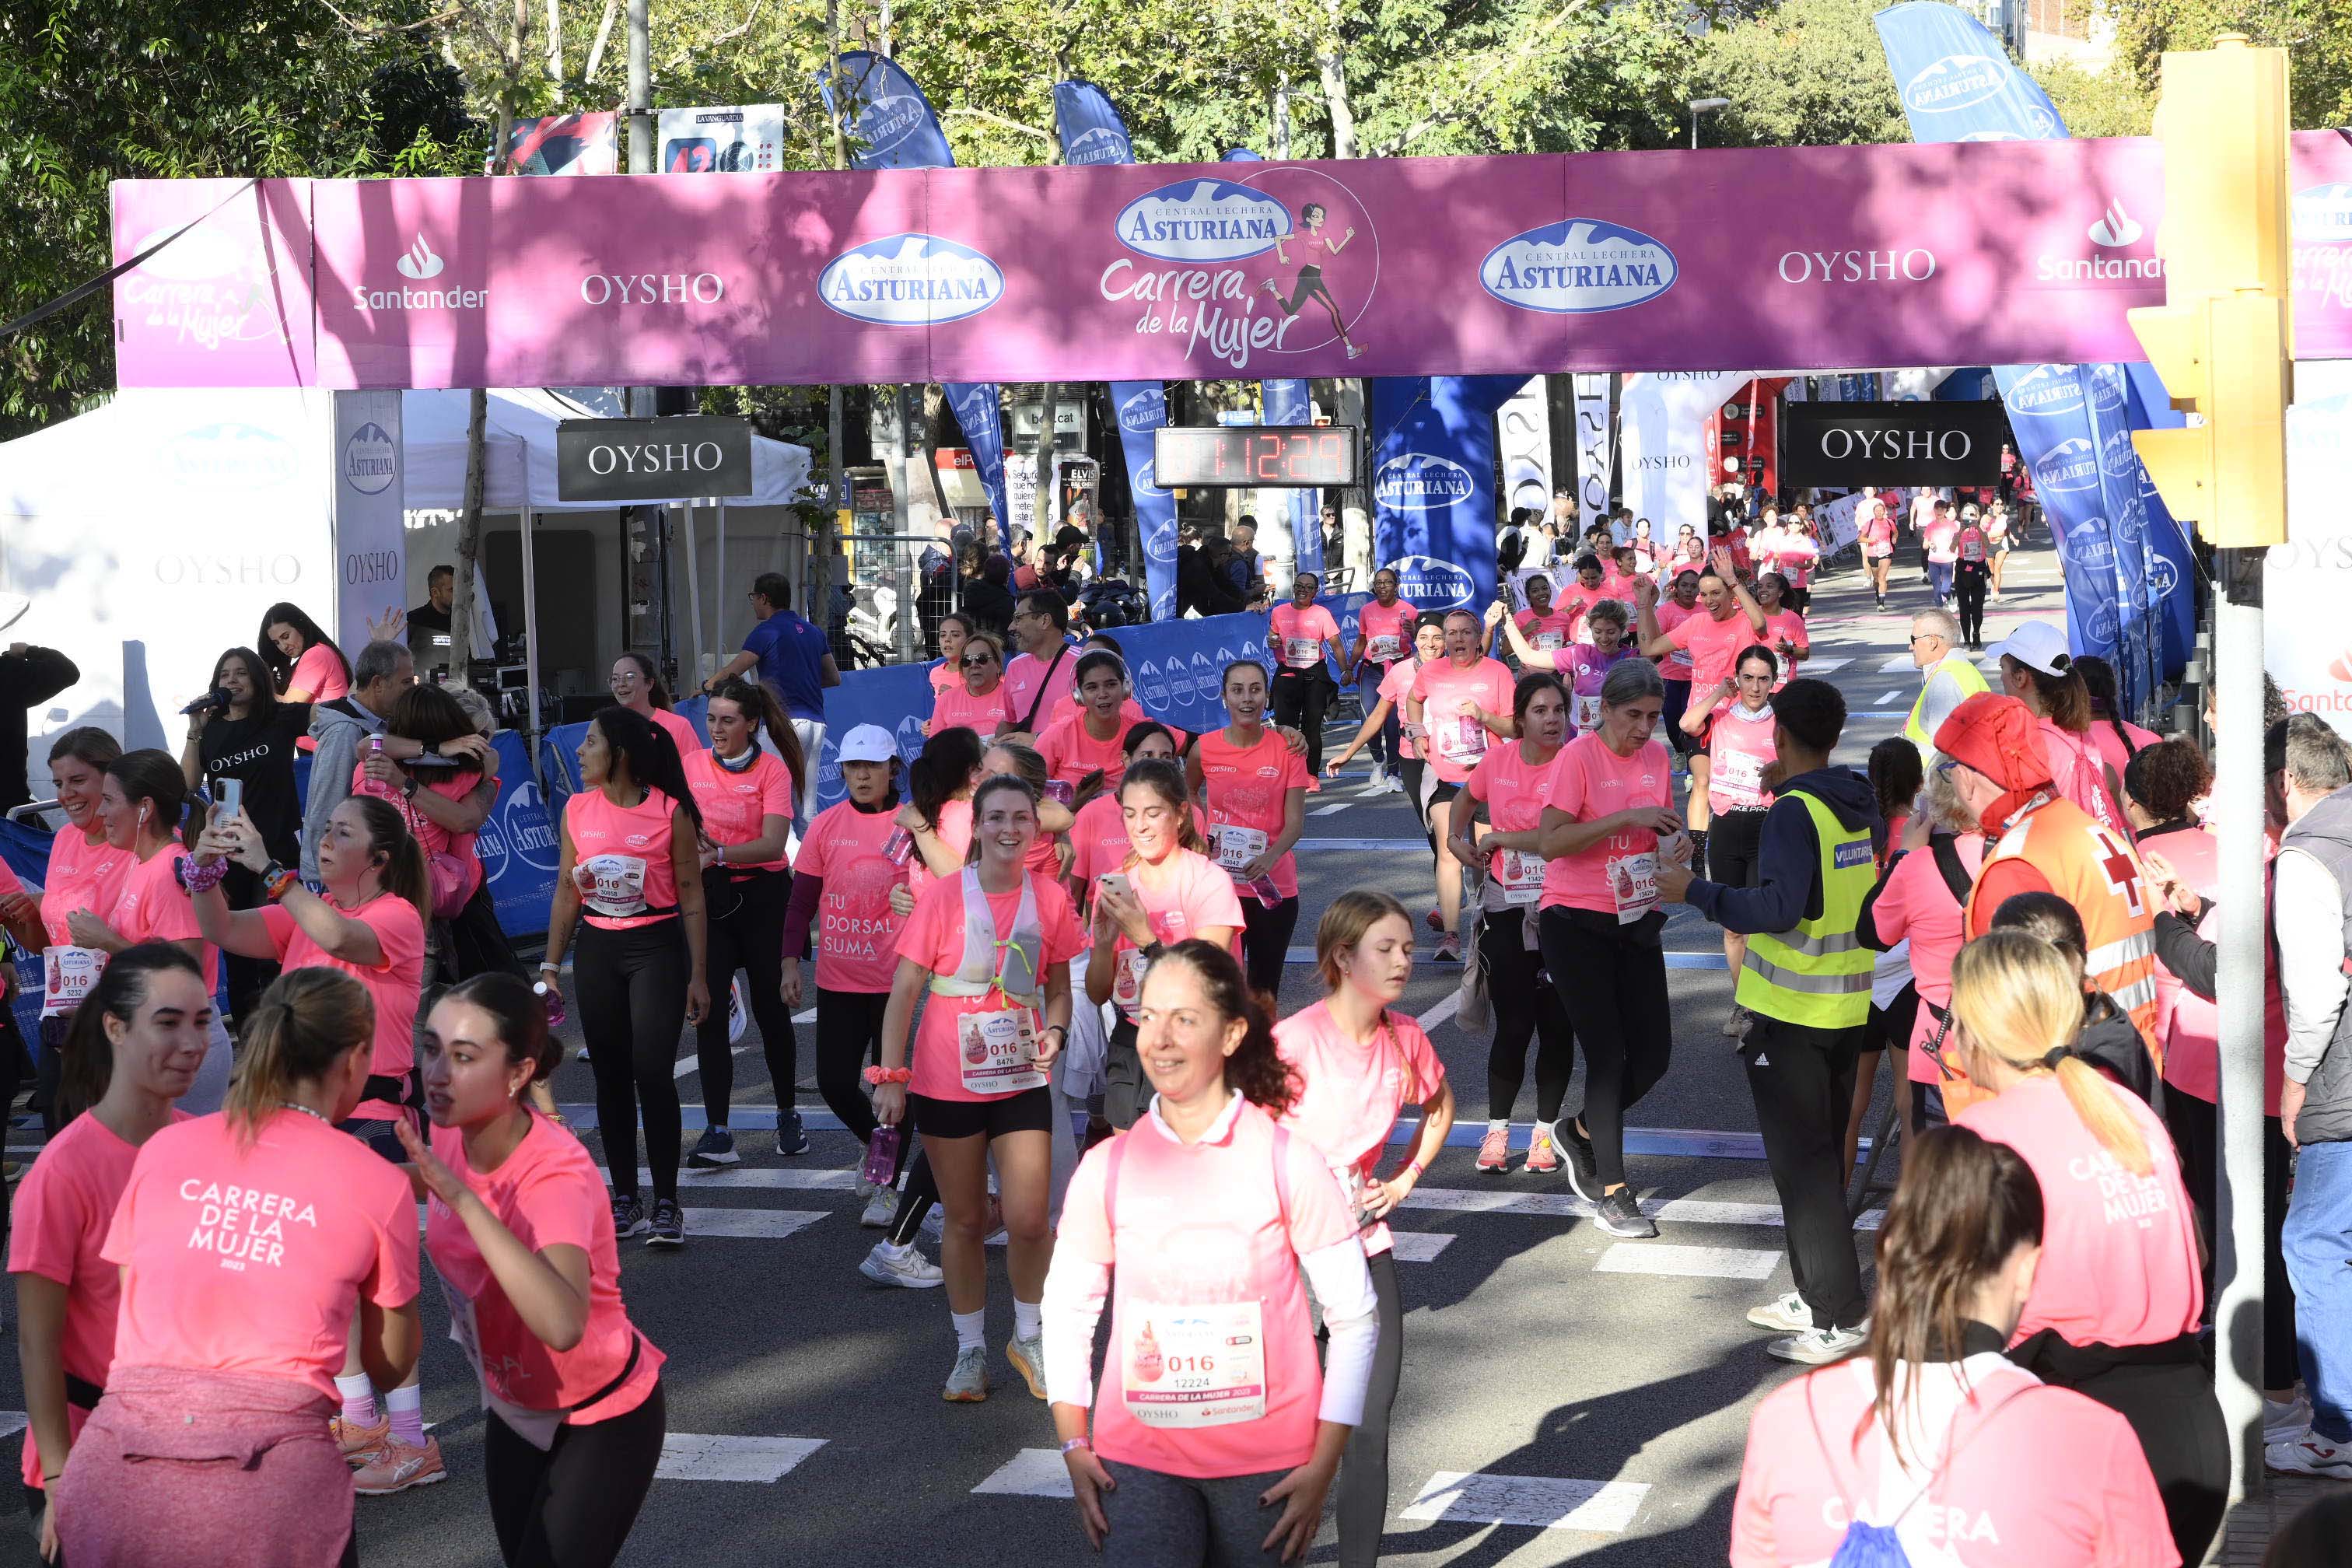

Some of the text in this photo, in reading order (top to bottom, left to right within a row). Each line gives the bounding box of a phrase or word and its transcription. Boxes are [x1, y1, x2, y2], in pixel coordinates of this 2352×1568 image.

[706, 114, 744, 122] VANGUARDIA
[1155, 205, 1272, 216] CENTRAL LECHERA
[1129, 210, 1279, 242] ASTURIANA
[1525, 249, 1657, 262] CENTRAL LECHERA
[1495, 255, 1663, 290] ASTURIANA
[1777, 248, 1937, 284] OYSHO
[2037, 254, 2166, 280] Santand
[580, 272, 724, 305] OYSHO
[831, 267, 990, 303] ASTURIANA
[1099, 258, 1245, 303] Carrera
[353, 285, 488, 310] Santander
[1136, 295, 1300, 369] de la Mujer
[1821, 428, 1972, 460] OYSHO
[348, 450, 394, 477] ASTURIANA
[587, 442, 723, 475] OYSHO
[1631, 454, 1690, 471] OYSHO
[1071, 469, 1095, 479] ELVIS
[1377, 476, 1467, 499] ASTURIANA
[154, 553, 302, 586] OYSHO
[345, 550, 398, 586] OYSHO
[210, 744, 269, 772] OYSHO
[1210, 765, 1237, 774] OYSHO
[1728, 768, 1747, 779] 016
[692, 780, 717, 789] OYSHO
[1494, 777, 1518, 787] OYSHO
[1213, 808, 1230, 824] TU
[580, 830, 606, 838] OYSHO
[1608, 835, 1629, 850] TU
[830, 838, 859, 848] OYSHO
[1223, 848, 1244, 859] 016
[1836, 845, 1873, 863] VOLUNTARIS
[1524, 865, 1545, 874] 016
[597, 877, 619, 889] 016
[1635, 877, 1656, 890] 016
[827, 892, 846, 909] TU
[1638, 889, 1654, 898] 13429
[825, 915, 894, 935] DORSAL
[824, 936, 877, 956] SUMA
[63, 975, 88, 987] 016
[990, 1042, 1017, 1056] 016
[996, 1058, 1014, 1066] 8476
[971, 1080, 998, 1090] OYSHO
[1017, 1075, 1038, 1084] Santander
[2098, 1172, 2130, 1199] DE
[180, 1178, 317, 1228] CARRERA
[2103, 1188, 2170, 1225] MUJER
[200, 1203, 283, 1242] DE LA
[187, 1227, 285, 1268] MUJER
[1168, 1355, 1215, 1372] 016
[1174, 1377, 1210, 1389] 12224
[1139, 1392, 1176, 1402] CARRERA
[1177, 1393, 1190, 1402] DE
[1190, 1392, 1201, 1401] LA
[1202, 1390, 1230, 1401] MUJER
[1137, 1409, 1179, 1420] OYSHO
[1212, 1404, 1255, 1415] Santander
[1821, 1495, 2000, 1545] CAERA
